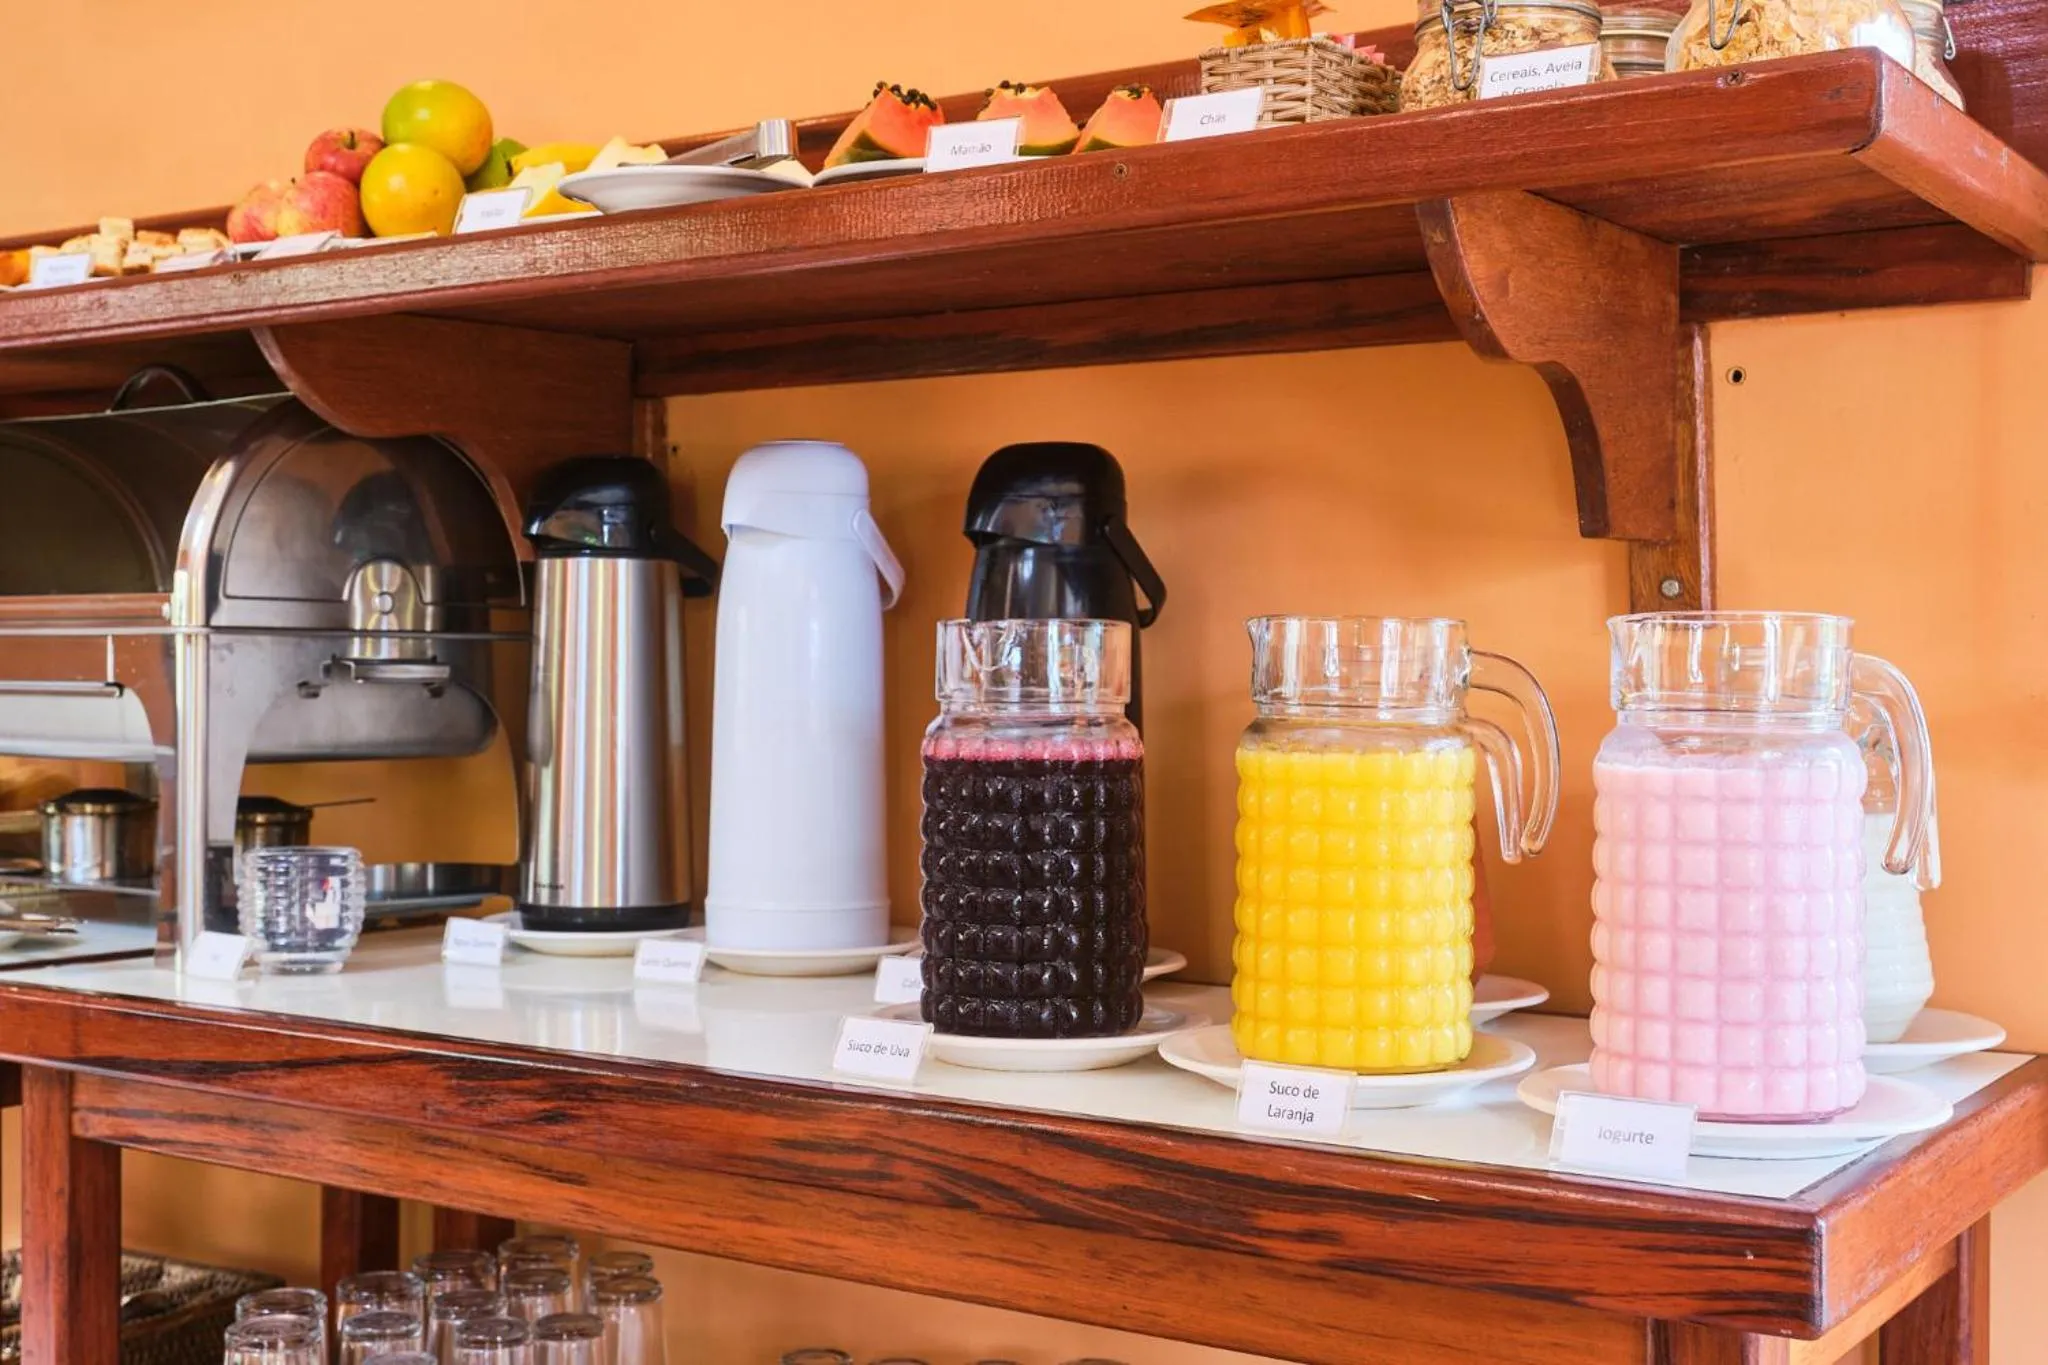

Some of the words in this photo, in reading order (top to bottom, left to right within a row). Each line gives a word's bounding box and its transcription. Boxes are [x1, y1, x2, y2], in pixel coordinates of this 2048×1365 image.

[1490, 65, 1541, 83] Cereais,
[1545, 60, 1582, 75] Aveia
[847, 1039, 872, 1053] Suco
[873, 1042, 888, 1055] de
[890, 1043, 910, 1058] Uva
[1269, 1080, 1300, 1097] Suco
[1303, 1084, 1320, 1100] de
[1267, 1104, 1315, 1125] Laranja
[1598, 1125, 1655, 1144] Iogurte
